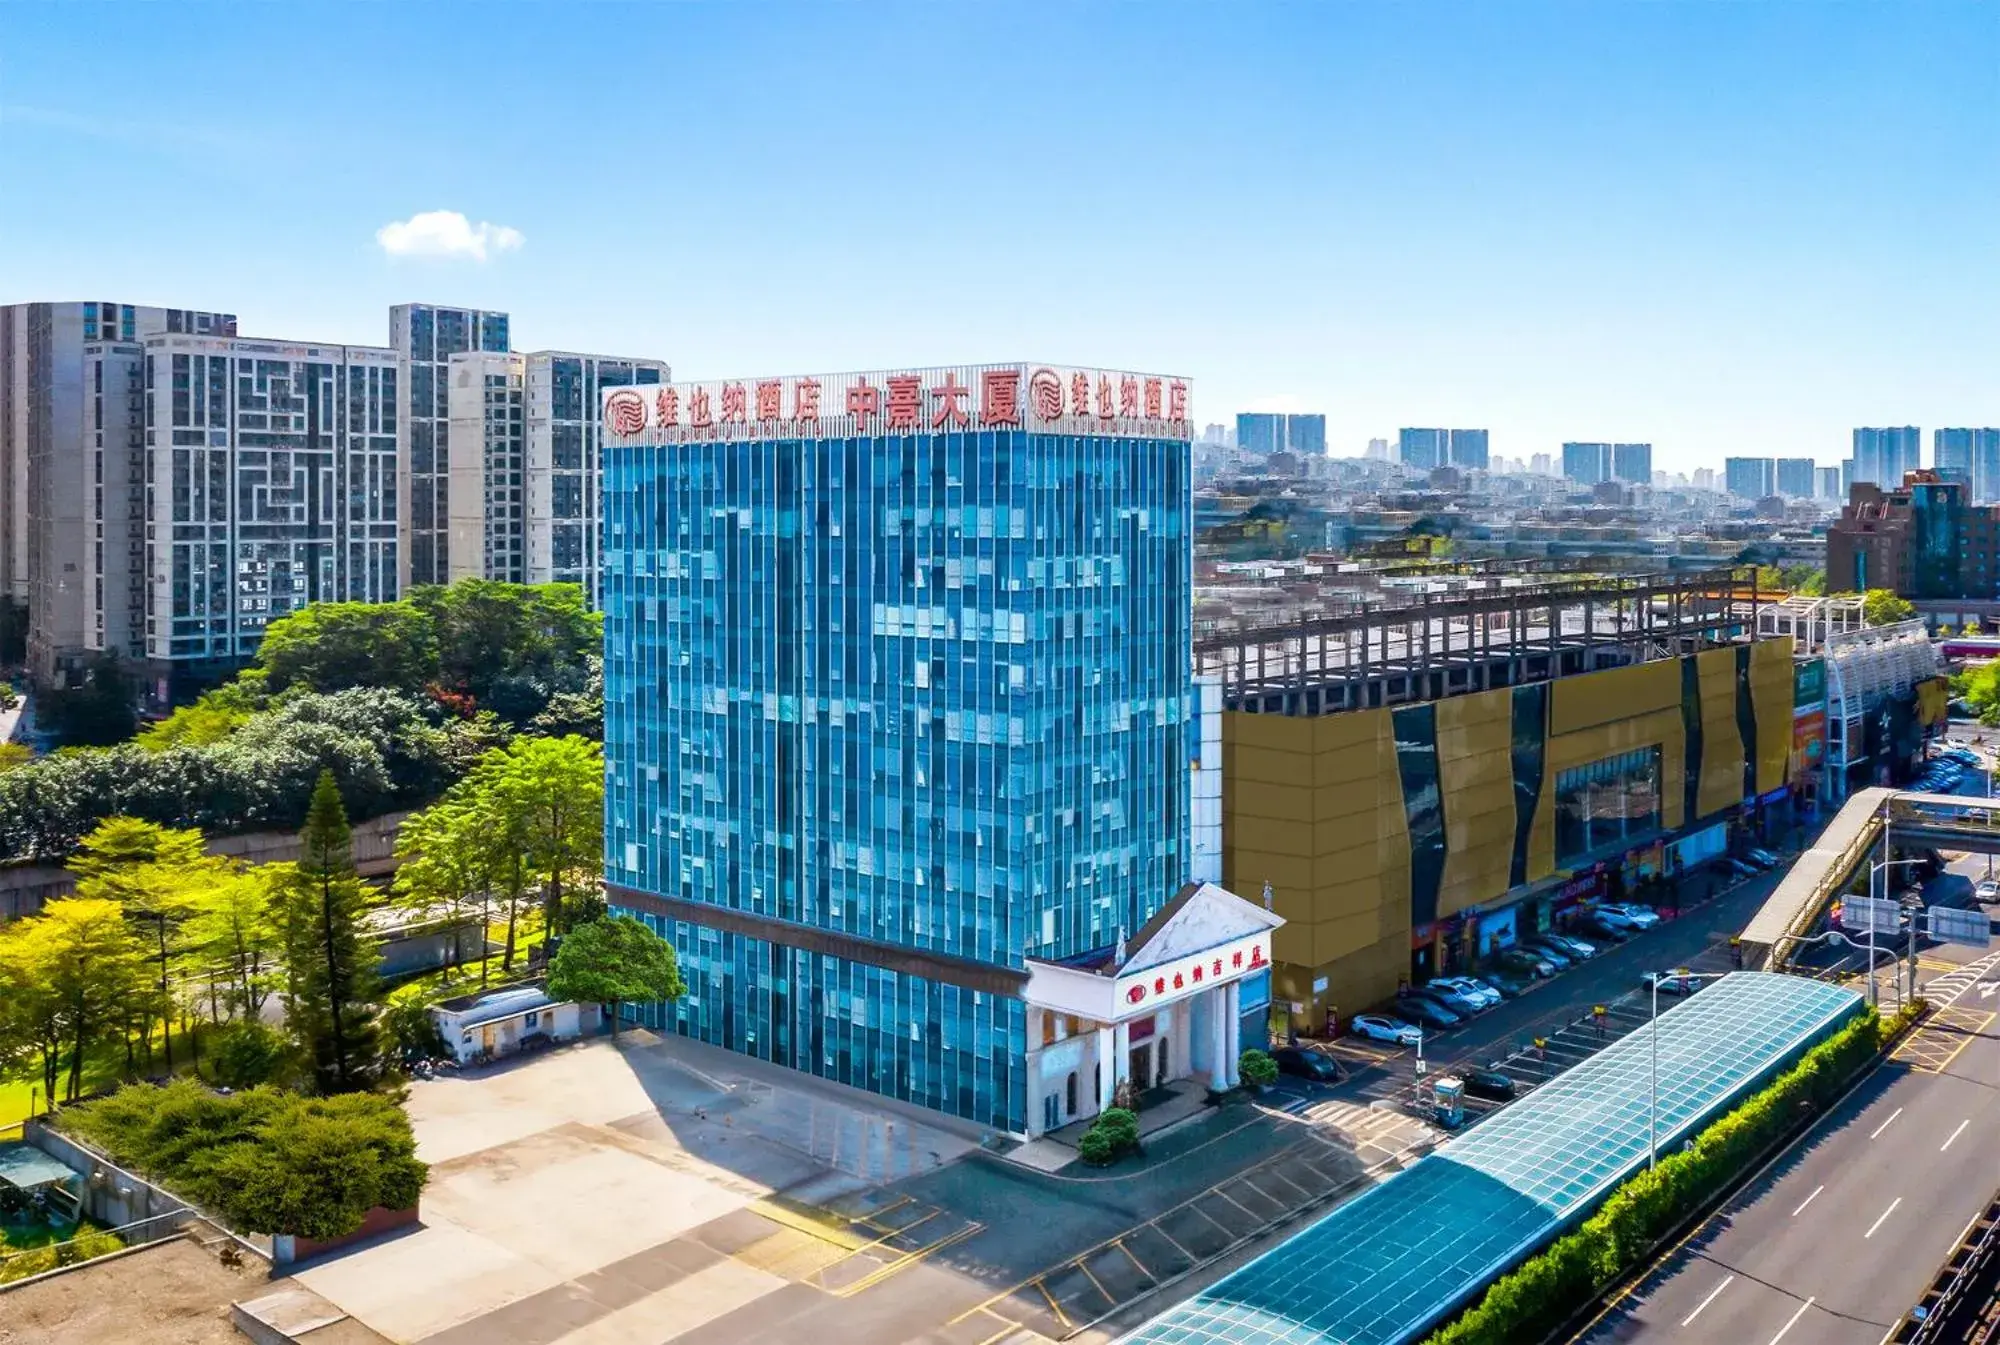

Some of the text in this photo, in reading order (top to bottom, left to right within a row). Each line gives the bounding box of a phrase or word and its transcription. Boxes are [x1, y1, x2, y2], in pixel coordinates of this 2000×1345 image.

[656, 376, 822, 427] 维也纳酒店
[1071, 371, 1187, 424] 维也纳酒店
